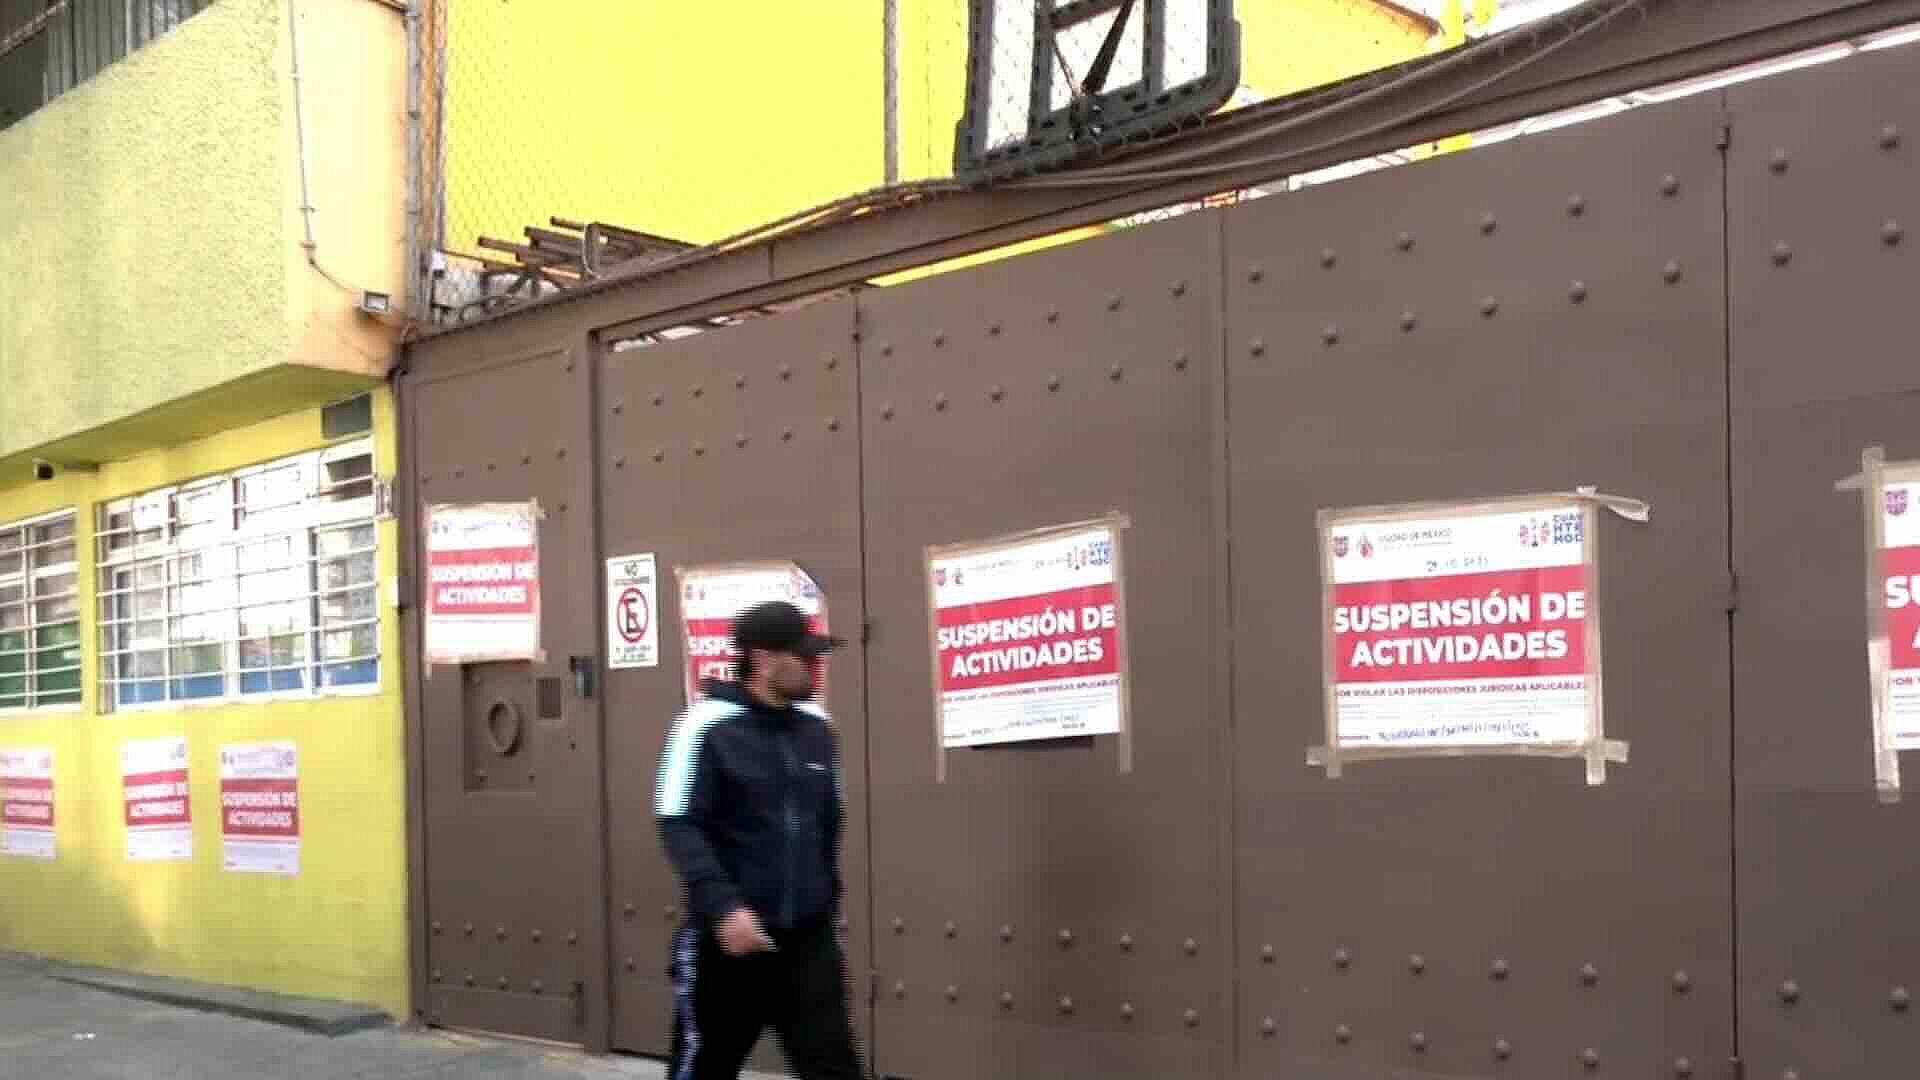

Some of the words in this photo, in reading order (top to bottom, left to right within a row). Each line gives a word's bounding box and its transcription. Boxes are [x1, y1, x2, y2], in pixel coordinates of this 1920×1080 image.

[936, 606, 1076, 650] SUSPENSIÓN
[1081, 605, 1116, 631] DE
[1333, 588, 1531, 634] SUSPENSIÓN
[1539, 590, 1585, 621] DE
[951, 637, 1104, 679] ACTIVIDADES
[1350, 628, 1568, 668] ACTIVIDADES
